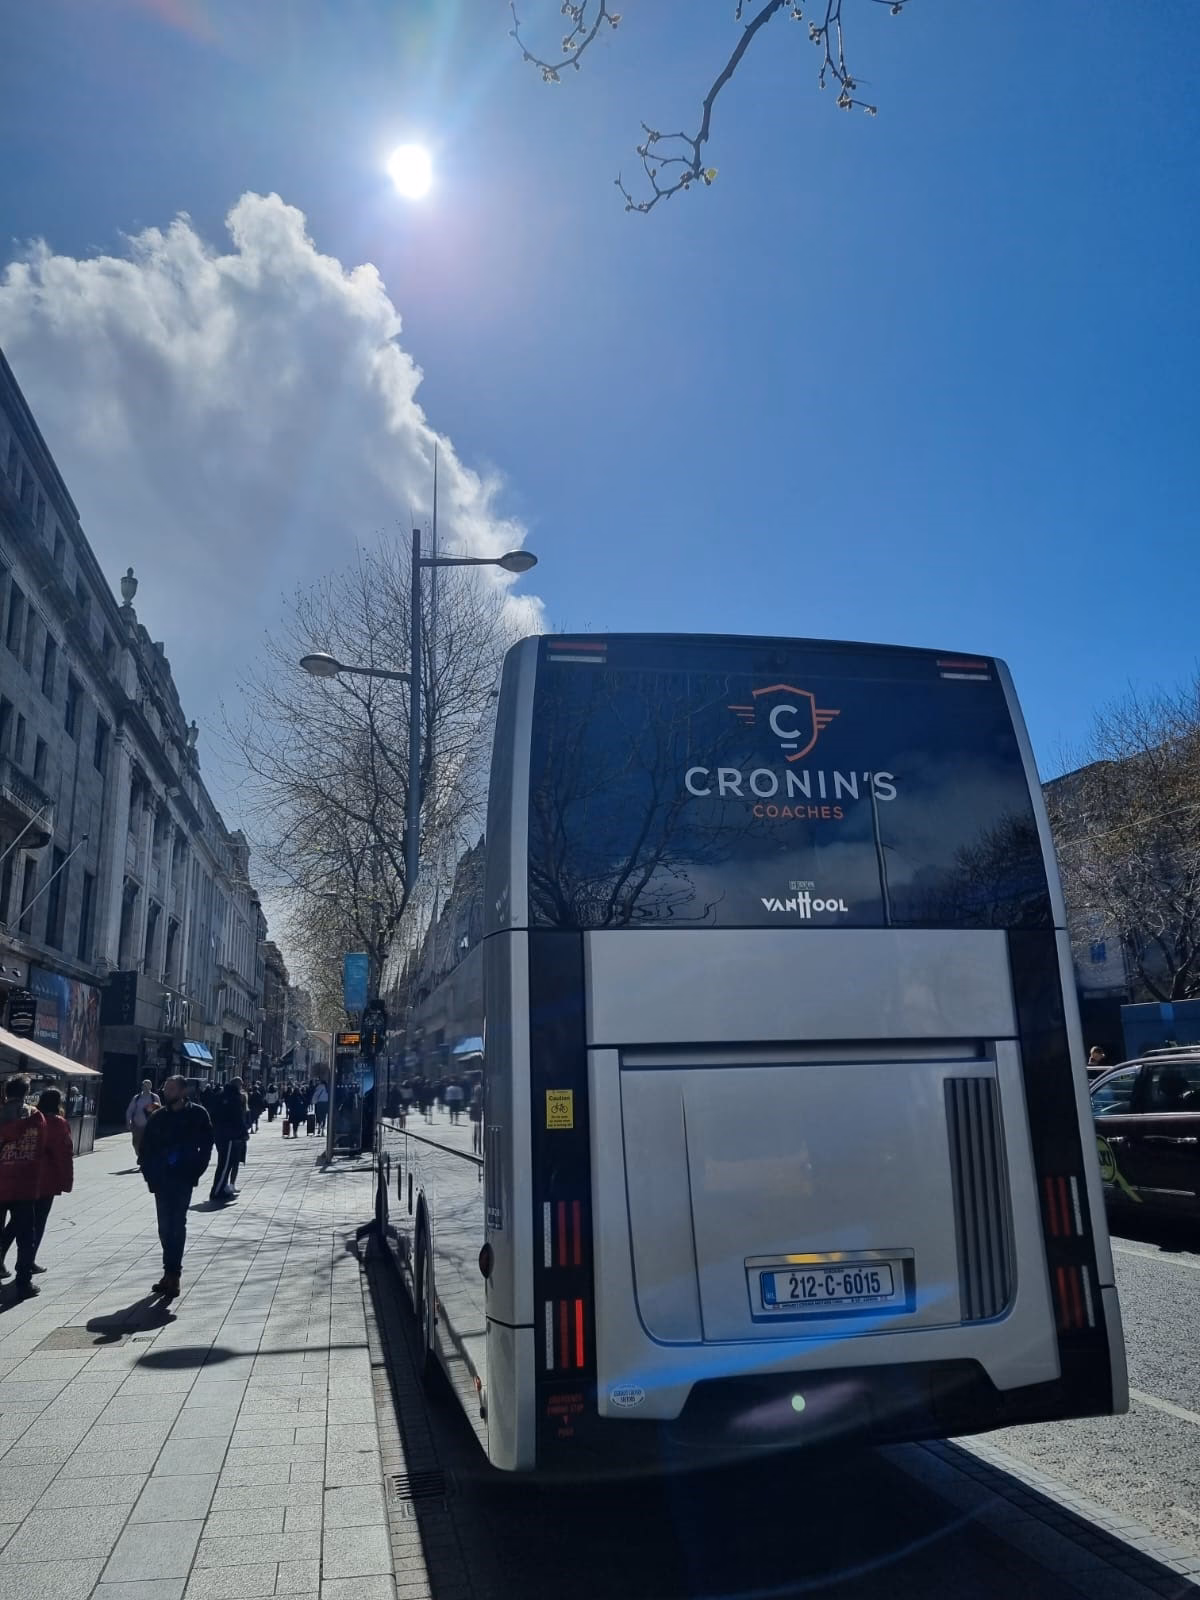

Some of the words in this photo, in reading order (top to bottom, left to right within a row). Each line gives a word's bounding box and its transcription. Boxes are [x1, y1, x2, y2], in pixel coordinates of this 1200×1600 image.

[769, 704, 801, 739] C
[684, 766, 897, 801] CRONIN'S
[752, 804, 844, 820] COACHES
[789, 1271, 881, 1299] 212-C-6015
